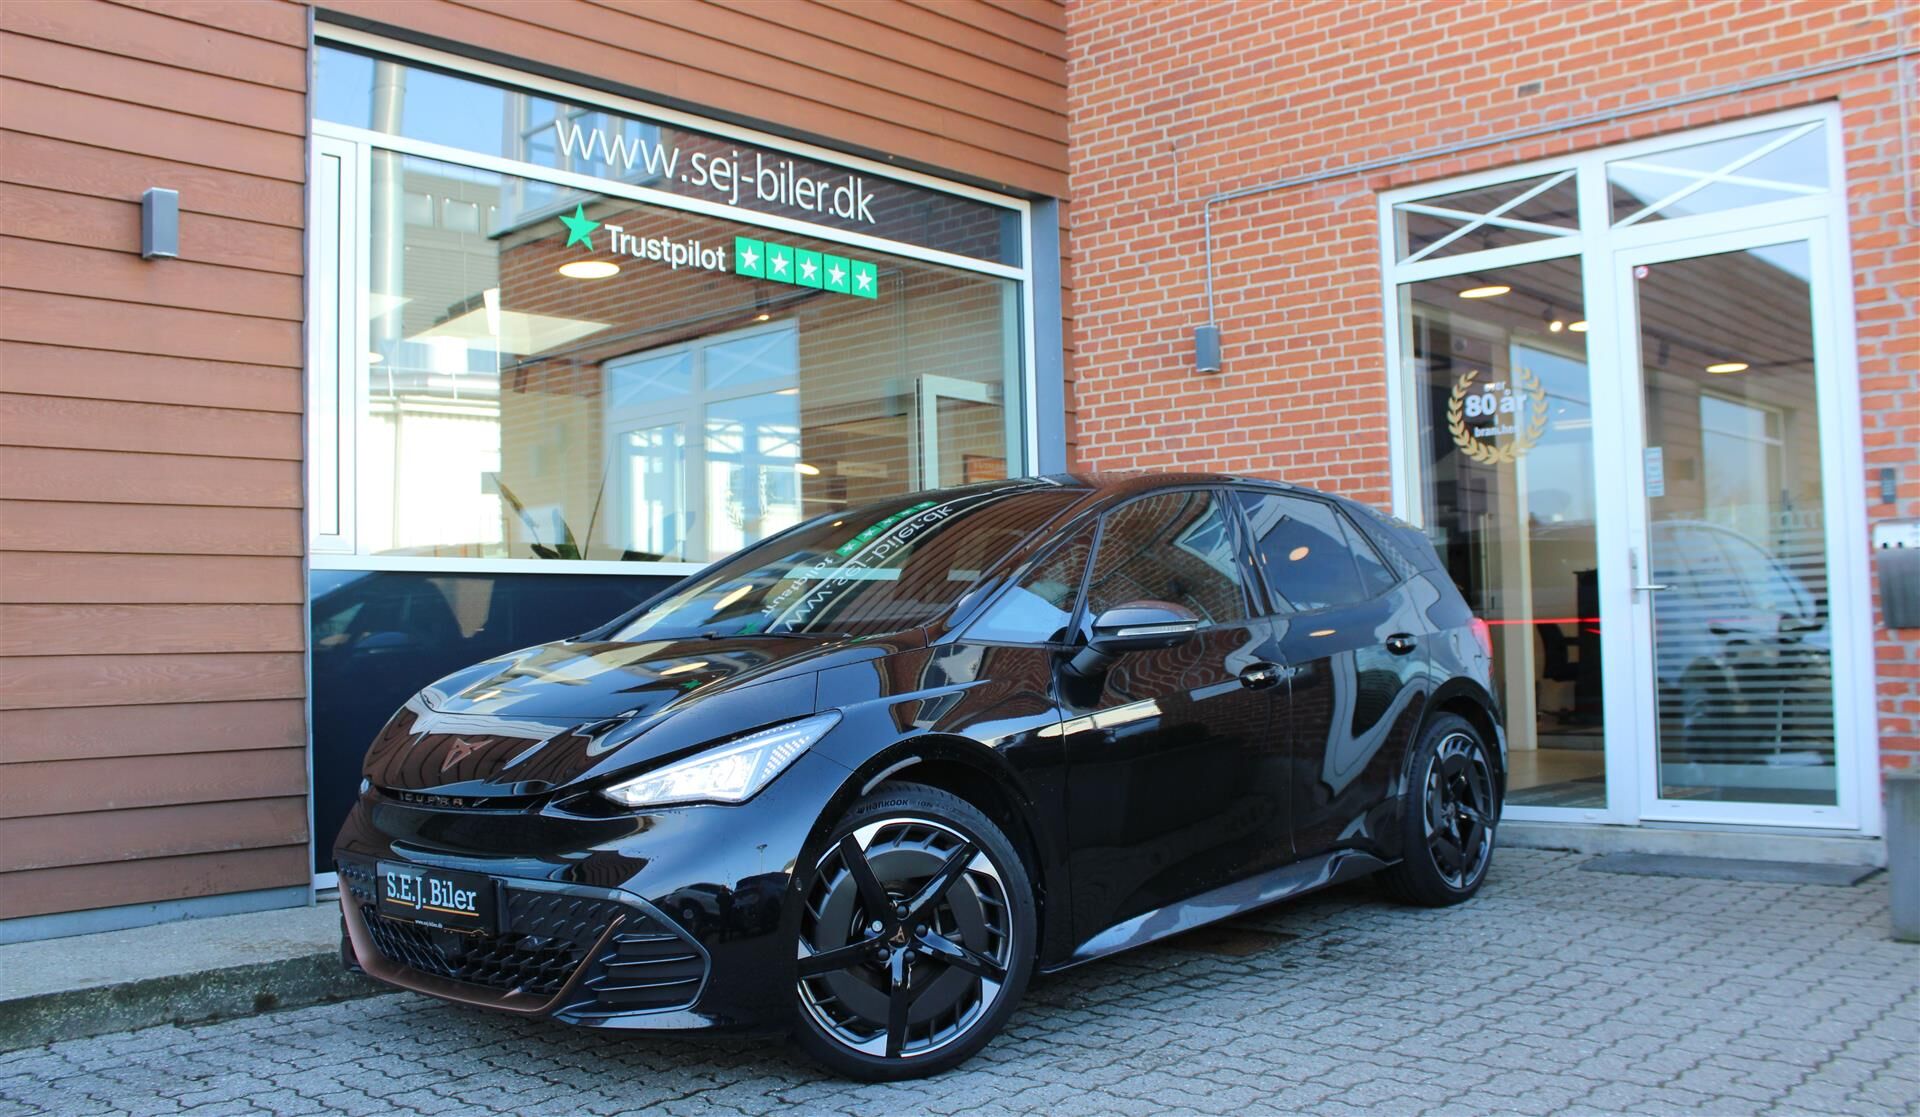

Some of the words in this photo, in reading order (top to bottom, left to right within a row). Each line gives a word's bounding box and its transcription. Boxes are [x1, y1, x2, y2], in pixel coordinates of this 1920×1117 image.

[555, 119, 877, 225] www.sej-biler.dk
[605, 223, 727, 273] Trustpilot
[1465, 393, 1497, 417] 80
[1500, 388, 1527, 413] år
[386, 871, 427, 910] S.E.J.
[430, 878, 476, 911] Biler
